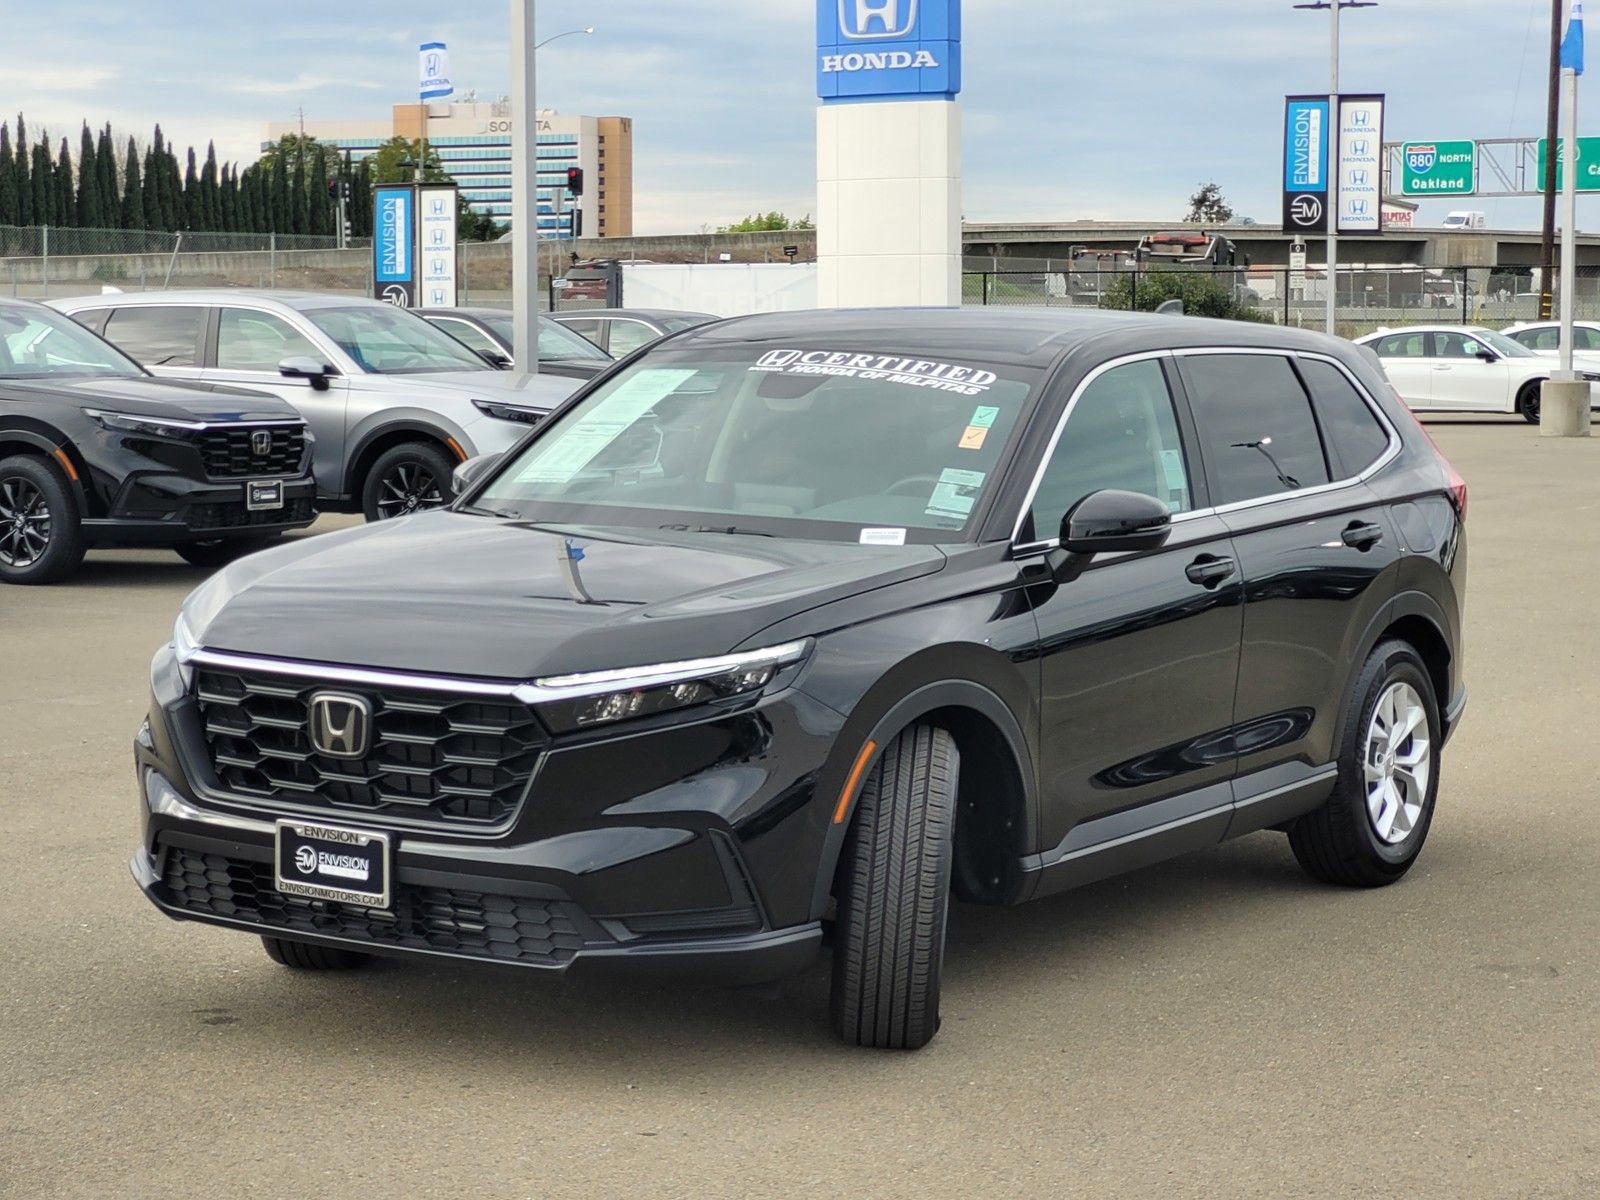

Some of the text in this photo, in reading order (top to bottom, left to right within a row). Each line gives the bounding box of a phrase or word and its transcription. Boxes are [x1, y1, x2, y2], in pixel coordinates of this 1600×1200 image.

[822, 51, 938, 72] HONDA
[489, 120, 551, 132] SOTA
[1293, 109, 1310, 184] ENVISION
[1410, 154, 1471, 167] 880 NORTH
[1411, 177, 1464, 189] Oakland
[383, 198, 396, 275] ENVISION
[801, 351, 997, 385] CERTIFIED
[788, 365, 857, 377] HONDA
[858, 370, 890, 380] OF
[886, 374, 982, 396] MILPITAS
[304, 826, 359, 843] ENVISION
[318, 852, 370, 871] ENVISION
[279, 881, 385, 907] ENVISIONMOTORS.COM
